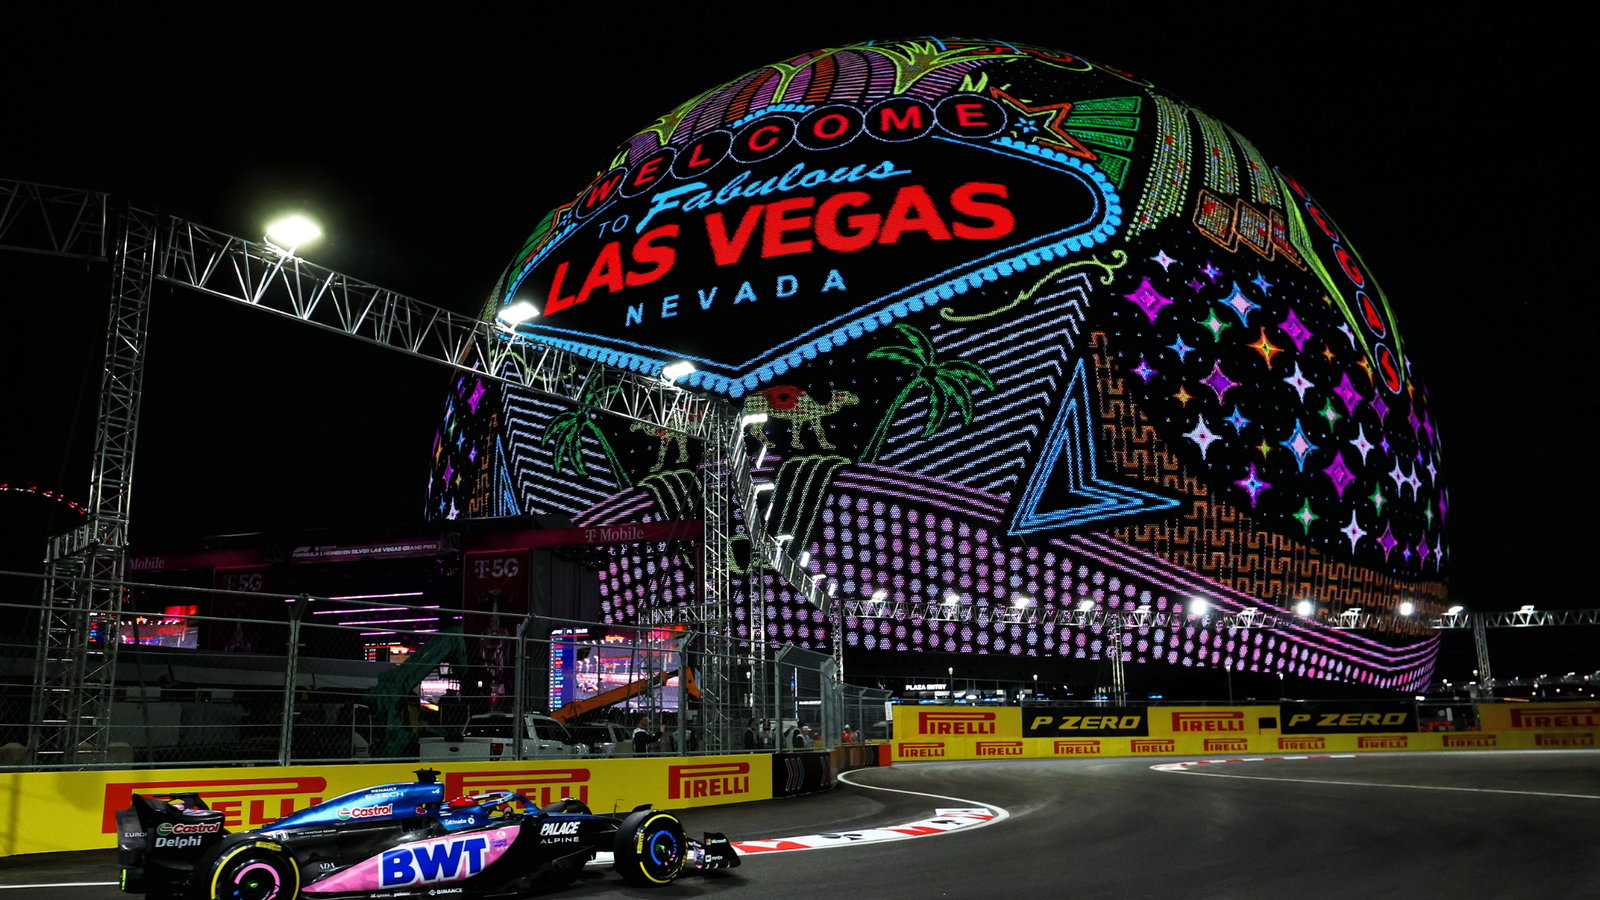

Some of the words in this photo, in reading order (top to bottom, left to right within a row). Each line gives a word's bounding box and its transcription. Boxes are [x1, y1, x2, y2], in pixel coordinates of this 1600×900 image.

[585, 103, 987, 208] WELCOME
[597, 213, 628, 239] TO
[635, 160, 912, 233] Fabulous
[543, 224, 680, 316] LAS
[704, 181, 1017, 267] VEGAS
[624, 268, 848, 327] NEVADA
[600, 528, 644, 542] Mobile
[919, 711, 996, 735] PIRELLI
[1030, 716, 1053, 730] P
[1058, 715, 1141, 730] ZERO
[1171, 711, 1244, 732] PIRELLI
[1288, 713, 1311, 727] P
[1316, 712, 1408, 726] ZERO
[1510, 706, 1600, 728] PIRELL
[1053, 740, 1101, 754] PIRELLI
[1130, 739, 1175, 753] PIRELLI
[1203, 737, 1248, 751] PIRELLI
[1277, 736, 1325, 750] PIRELLI
[1357, 735, 1408, 749] PIRELLI
[1442, 734, 1496, 747] PIRELLI
[1535, 733, 1595, 746] PIRELLI
[898, 742, 945, 757] PIRELLI
[976, 741, 1023, 756] PIRELLI
[668, 762, 750, 799] PIRELLI
[351, 804, 394, 818] Castrol
[173, 821, 221, 835] Castrol
[540, 821, 581, 836] PALACE
[155, 835, 202, 849] Delphi
[540, 836, 580, 845] ALPINE
[319, 862, 336, 870] ADA
[382, 837, 487, 886] BWT
